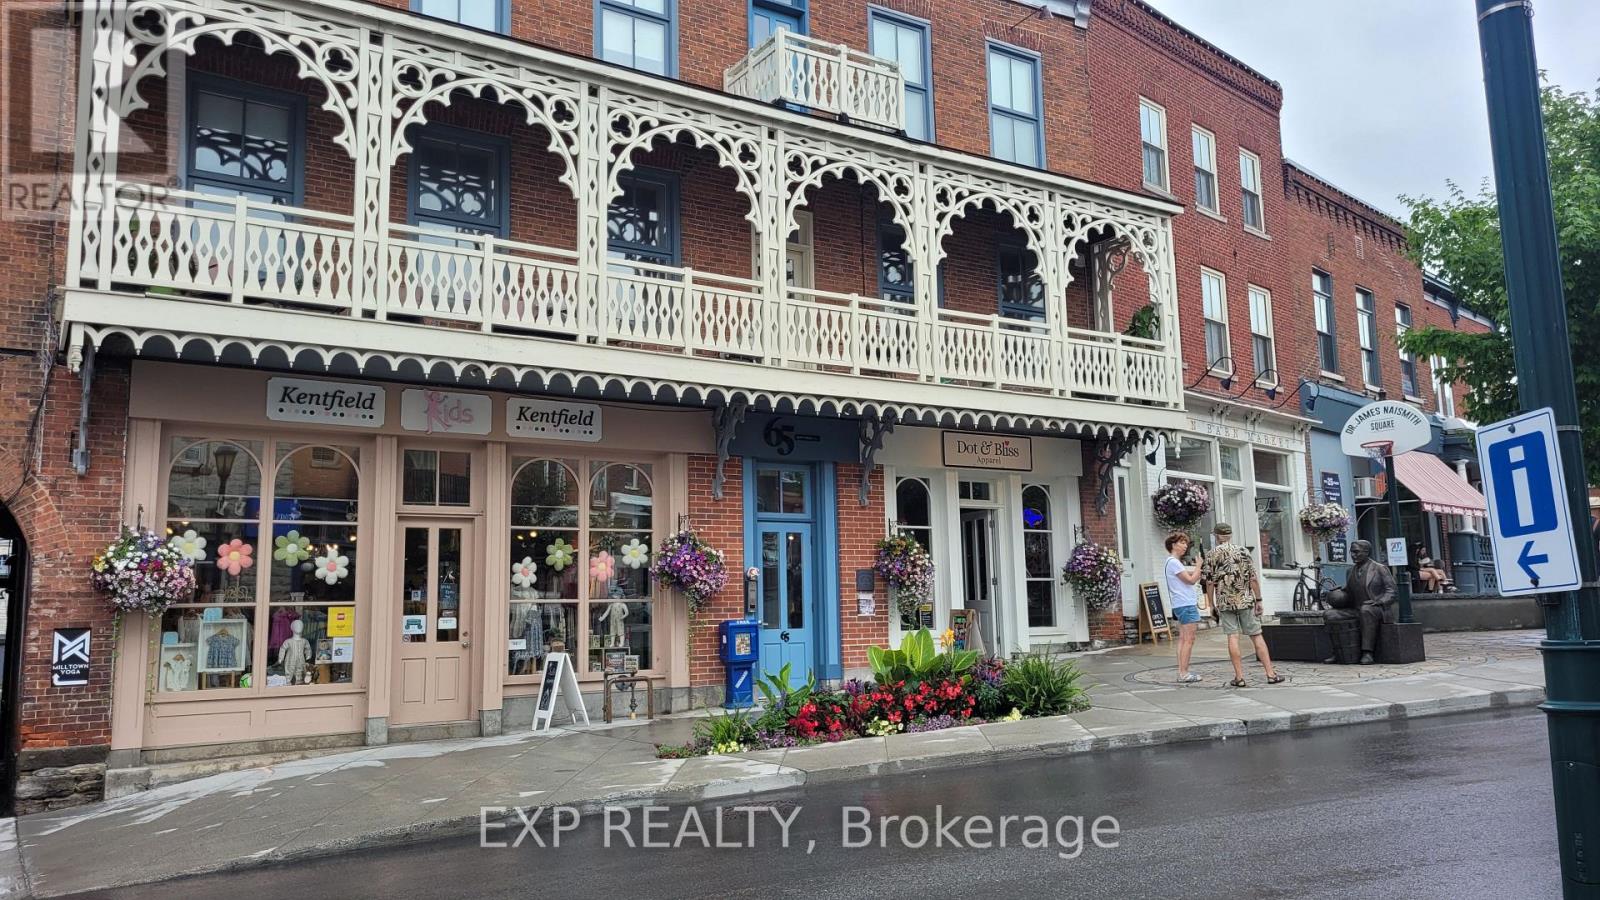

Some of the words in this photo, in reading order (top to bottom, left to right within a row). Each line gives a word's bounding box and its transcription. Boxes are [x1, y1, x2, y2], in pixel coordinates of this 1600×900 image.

[279, 386, 376, 411] Kentfield
[423, 389, 475, 434] Kids
[515, 406, 595, 427] Kentfield
[1354, 407, 1381, 426] JAMES
[1383, 406, 1422, 426] NAISMITH
[1370, 420, 1395, 431] SQUARE
[764, 416, 795, 456] 65
[957, 440, 978, 454] Dot
[980, 440, 993, 455] &
[994, 440, 1020, 457] Bliss
[976, 456, 1002, 465] Apparel
[780, 630, 790, 643] 65
